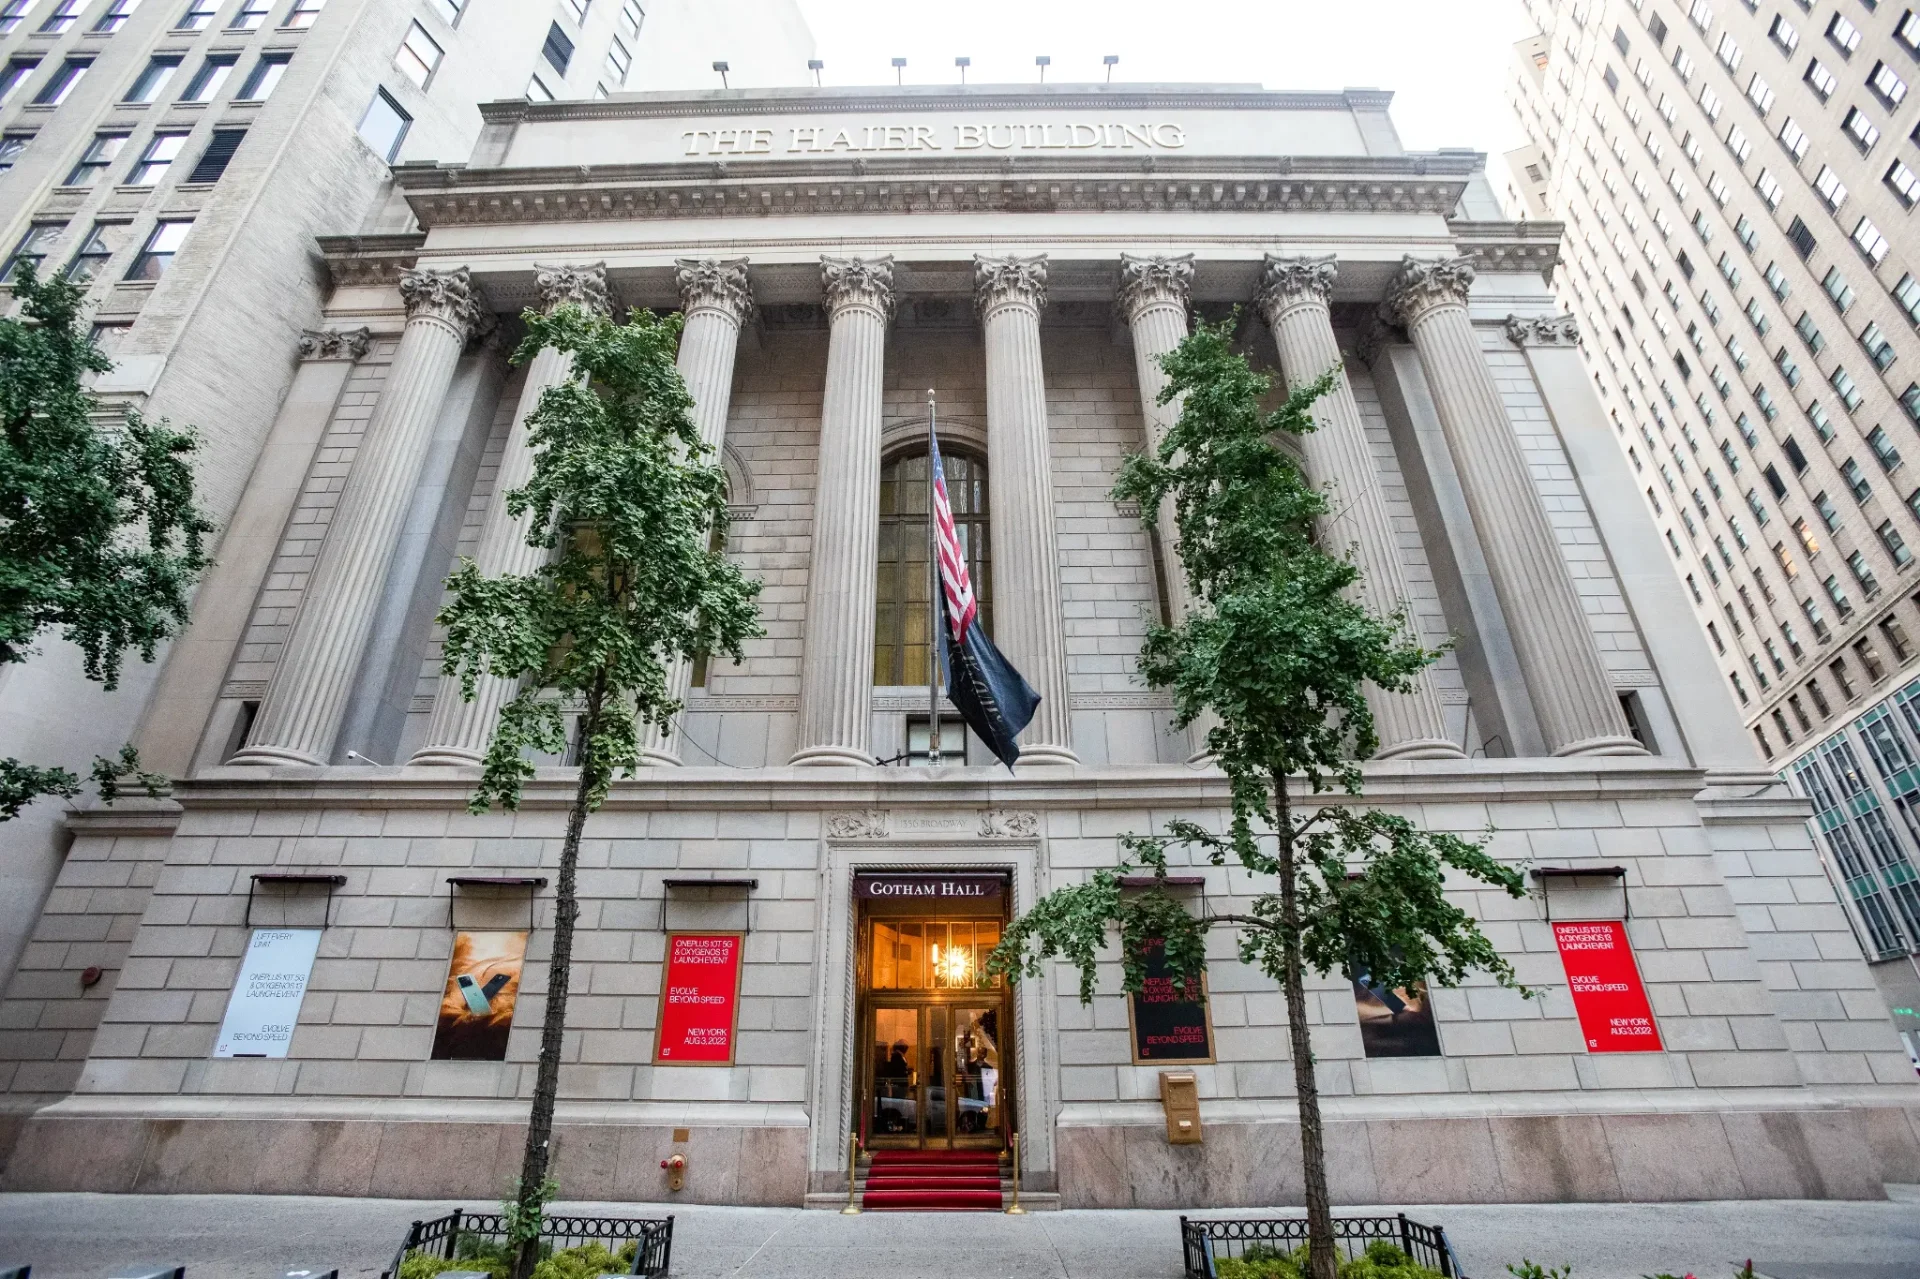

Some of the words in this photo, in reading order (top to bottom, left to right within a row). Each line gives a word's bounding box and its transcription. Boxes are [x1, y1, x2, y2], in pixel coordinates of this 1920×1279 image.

[681, 128, 773, 156] THE
[787, 125, 941, 153] HAIER
[954, 122, 1186, 150] BUILDING
[921, 819, 967, 829] BROADWAY
[1557, 926, 1590, 934] ONEPLUS
[271, 932, 294, 940] EVERY
[1566, 934, 1604, 942] OXYGENOS
[676, 940, 710, 948] ONEPLUS
[710, 940, 722, 948] 10T
[723, 940, 733, 948] 5G
[1592, 942, 1614, 950] EVENT
[675, 948, 680, 956] &
[680, 948, 720, 956] OXYGENOS
[721, 948, 729, 956] 13
[674, 956, 704, 964] LAUNCH
[705, 956, 728, 964] EVENT
[1571, 976, 1600, 984] EVOLVE
[670, 987, 699, 995] EVOLVE
[1573, 984, 1604, 992] BEYOND
[1605, 983, 1629, 991] SPEED
[669, 996, 701, 1004] BEYOND
[701, 996, 725, 1004] SPEED
[1610, 1018, 1628, 1026] NEW
[1629, 1018, 1650, 1026] YORK
[261, 1025, 291, 1033] EVOLVE
[688, 1028, 707, 1036] NEW
[707, 1028, 727, 1036] YORK
[1173, 1026, 1202, 1034] EVOLVE
[1610, 1027, 1627, 1035] AUG
[1634, 1027, 1652, 1035] 2022
[233, 1033, 263, 1041] BEYOND
[263, 1033, 288, 1041] SPEED
[684, 1037, 700, 1045] AUG
[708, 1037, 727, 1045] 2022
[1147, 1035, 1179, 1044] BEYOND
[1180, 1035, 1204, 1043] SPEED
